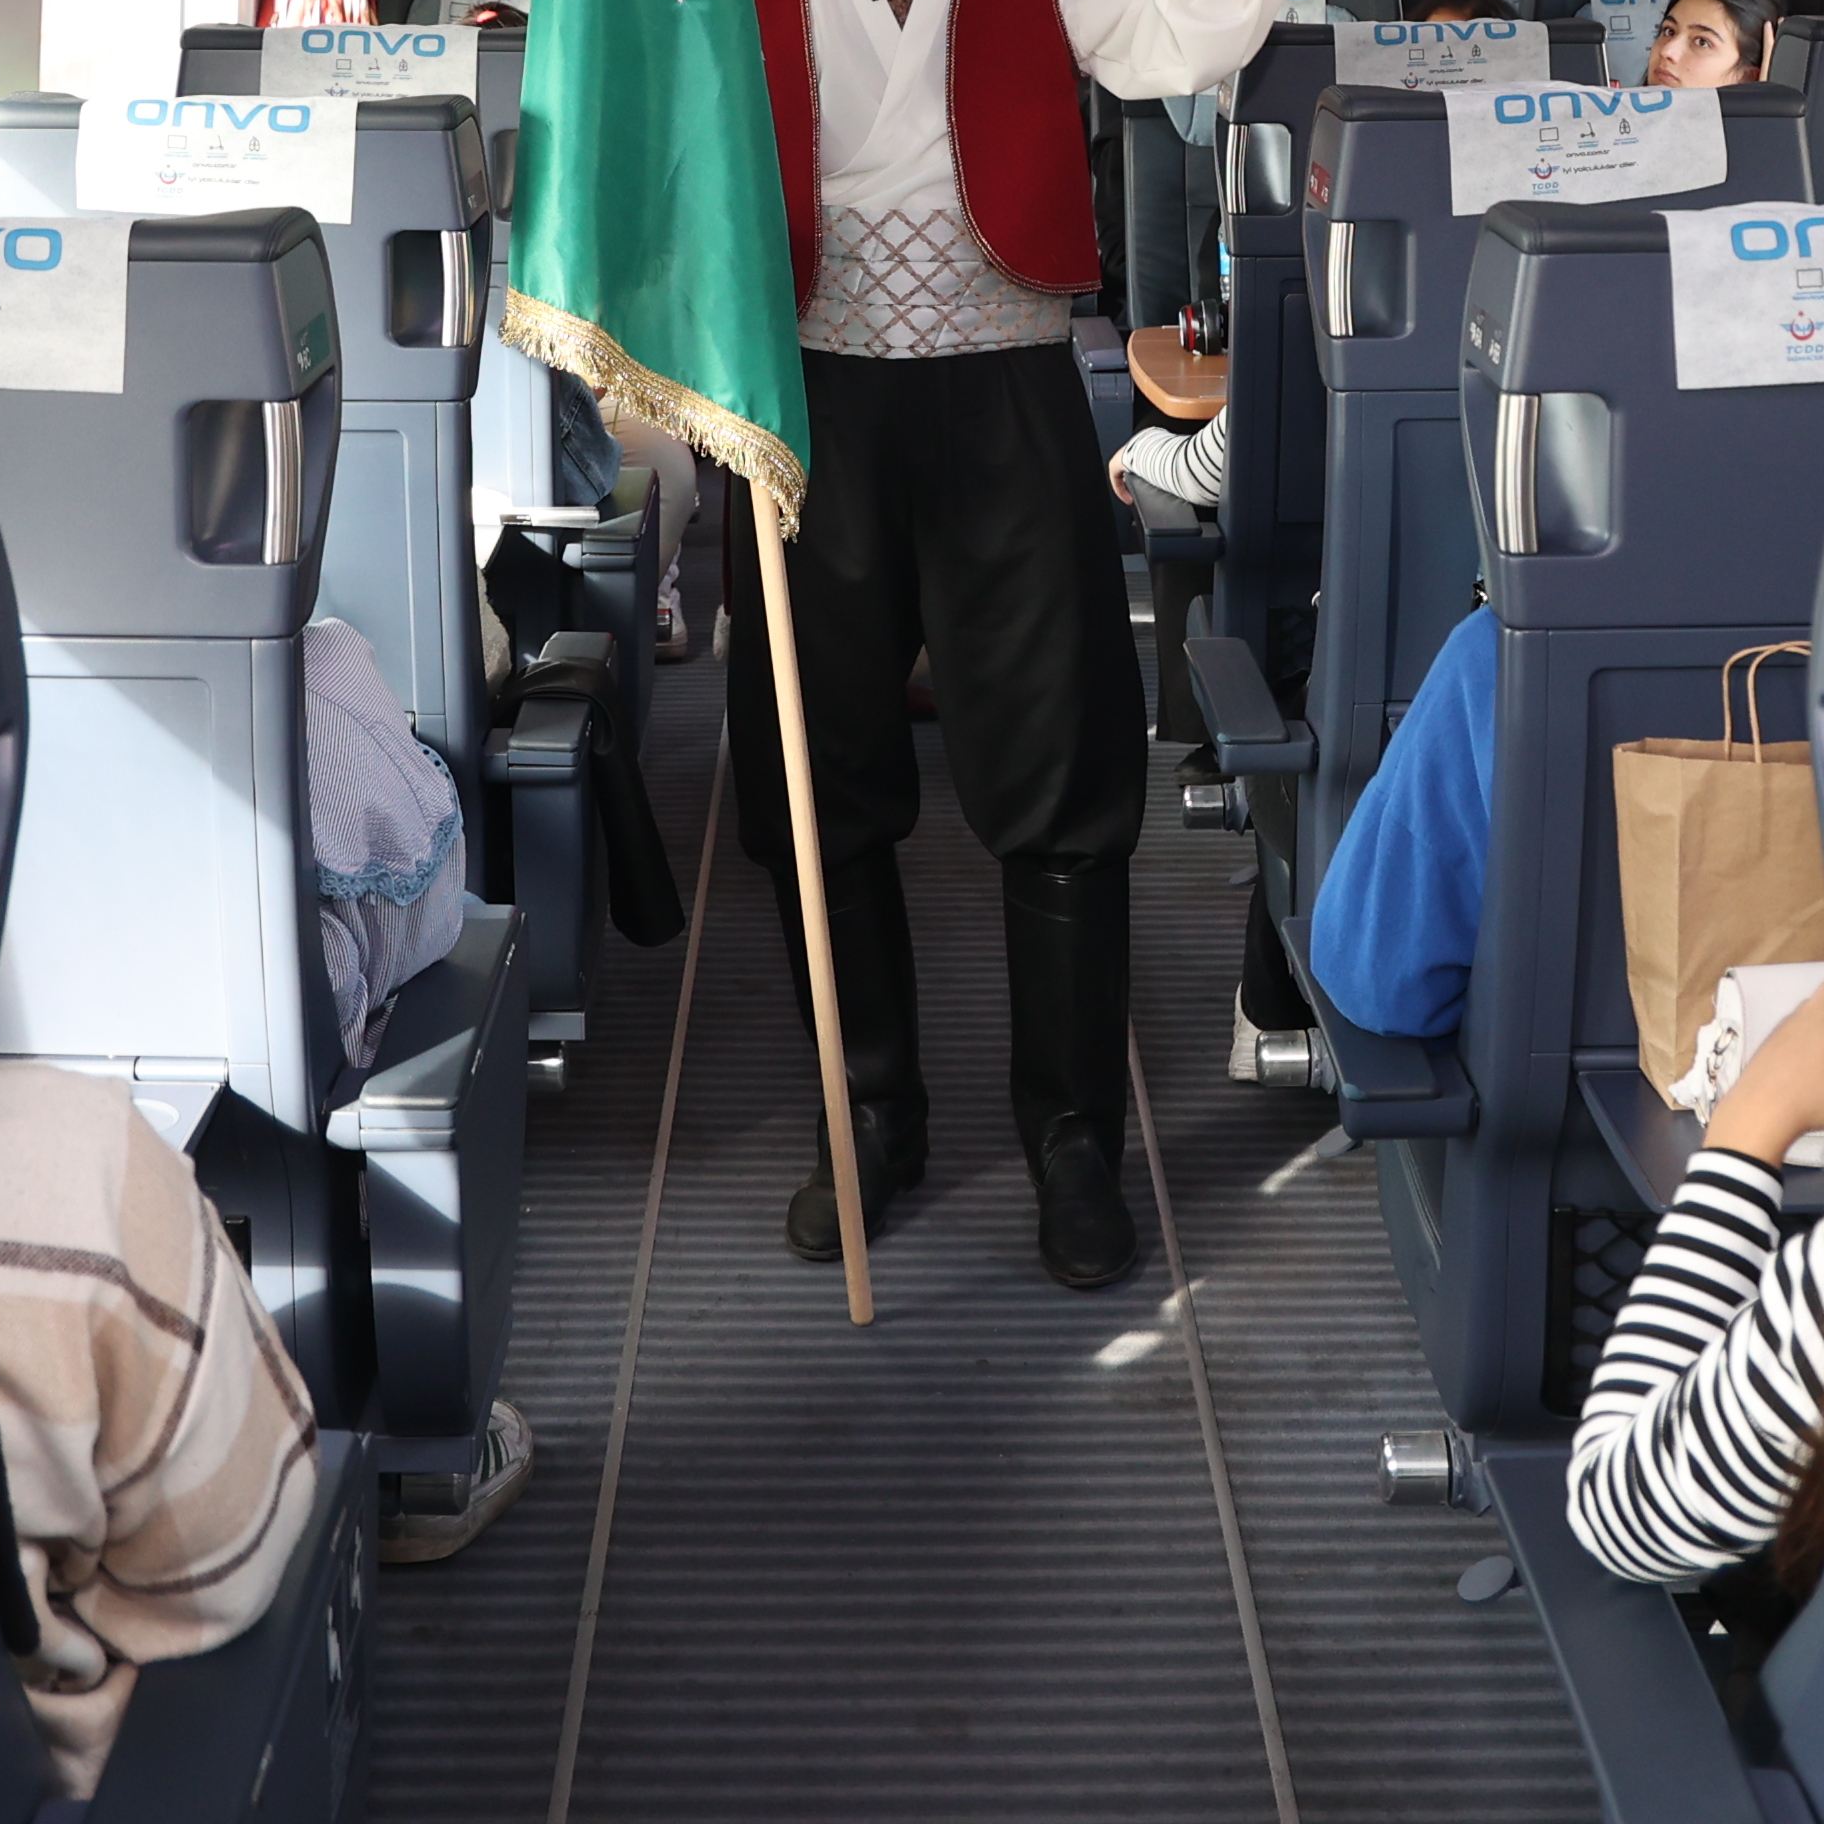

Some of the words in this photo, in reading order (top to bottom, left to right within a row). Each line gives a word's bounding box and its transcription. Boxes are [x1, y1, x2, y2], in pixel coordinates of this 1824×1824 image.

[301, 29, 446, 57] onvo
[1374, 22, 1516, 46] onvo
[127, 99, 311, 133] onvo
[1494, 90, 1673, 125] onvo
[1786, 345, 1824, 354] TCDD
